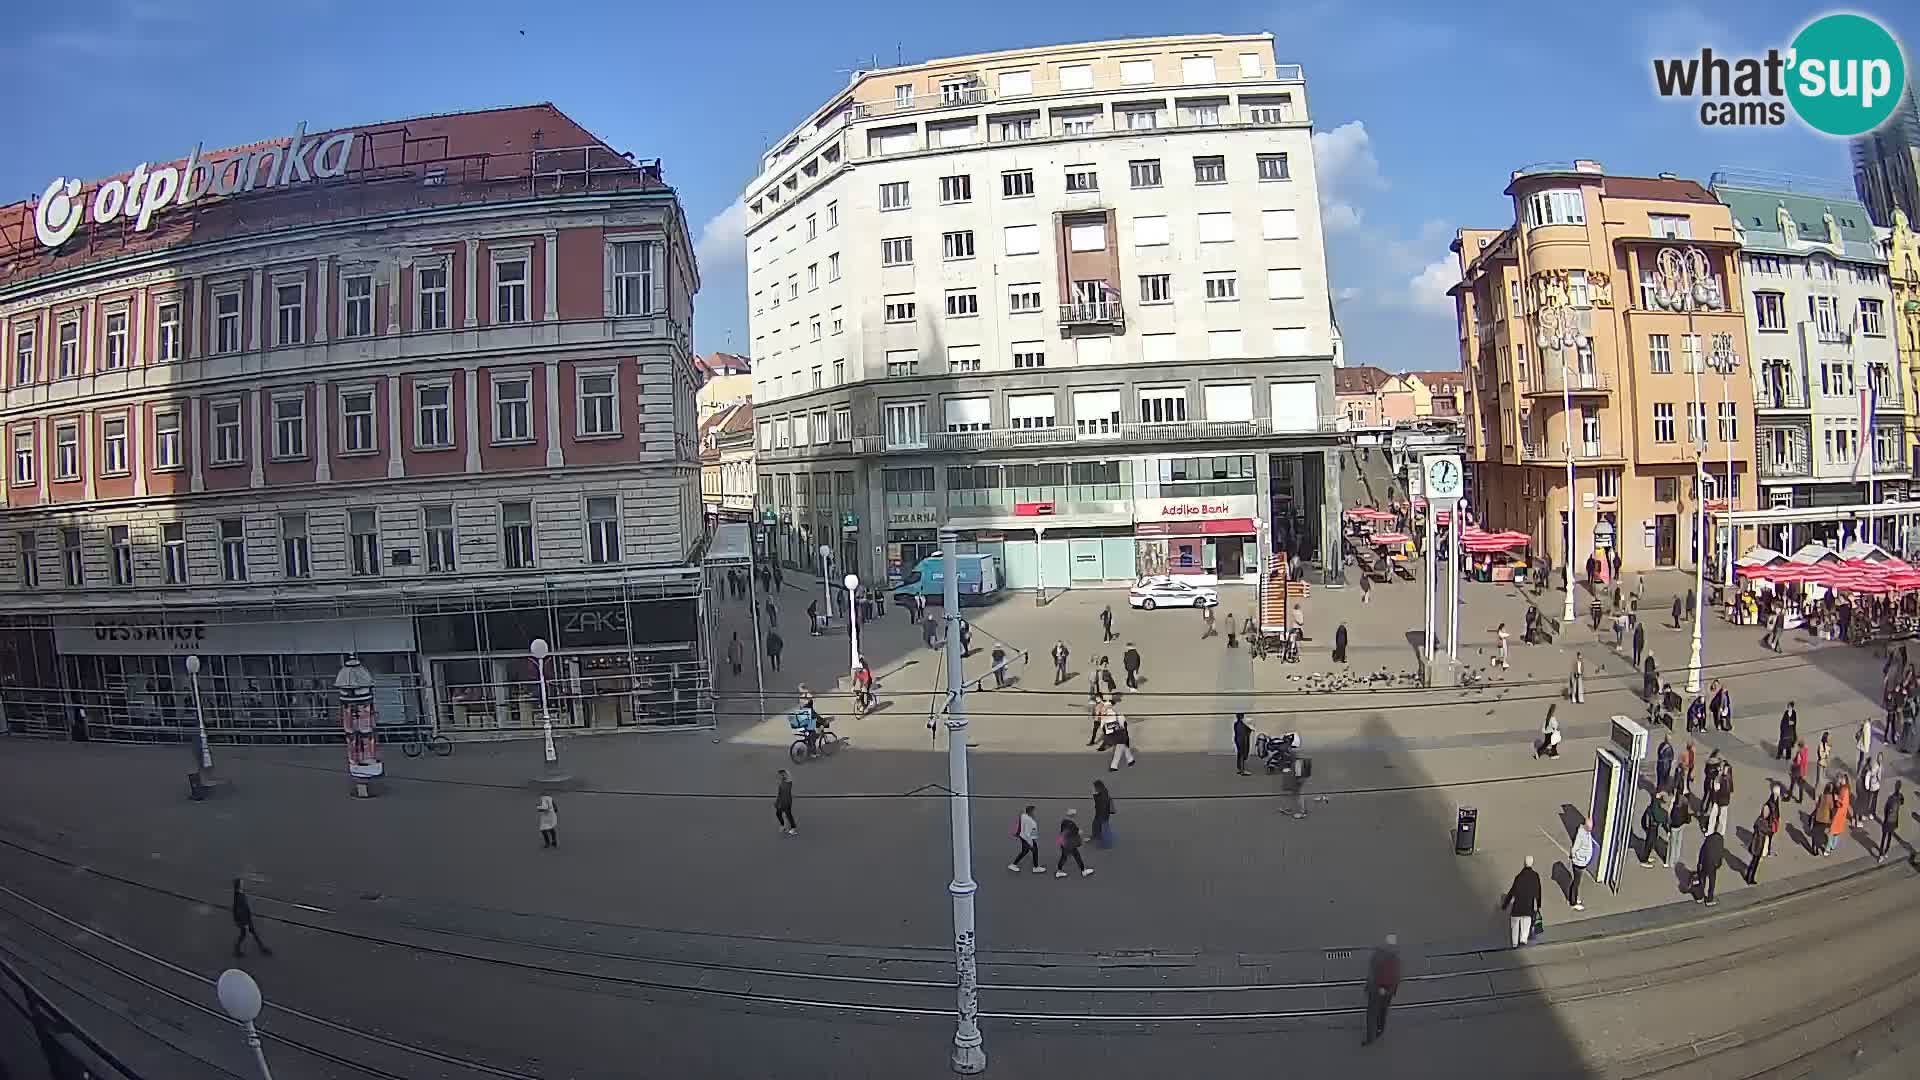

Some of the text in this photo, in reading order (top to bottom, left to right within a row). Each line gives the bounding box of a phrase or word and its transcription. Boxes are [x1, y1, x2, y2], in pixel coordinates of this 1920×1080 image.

[1162, 504, 1229, 515] Addiko Bank
[561, 611, 625, 632] ZAKS
